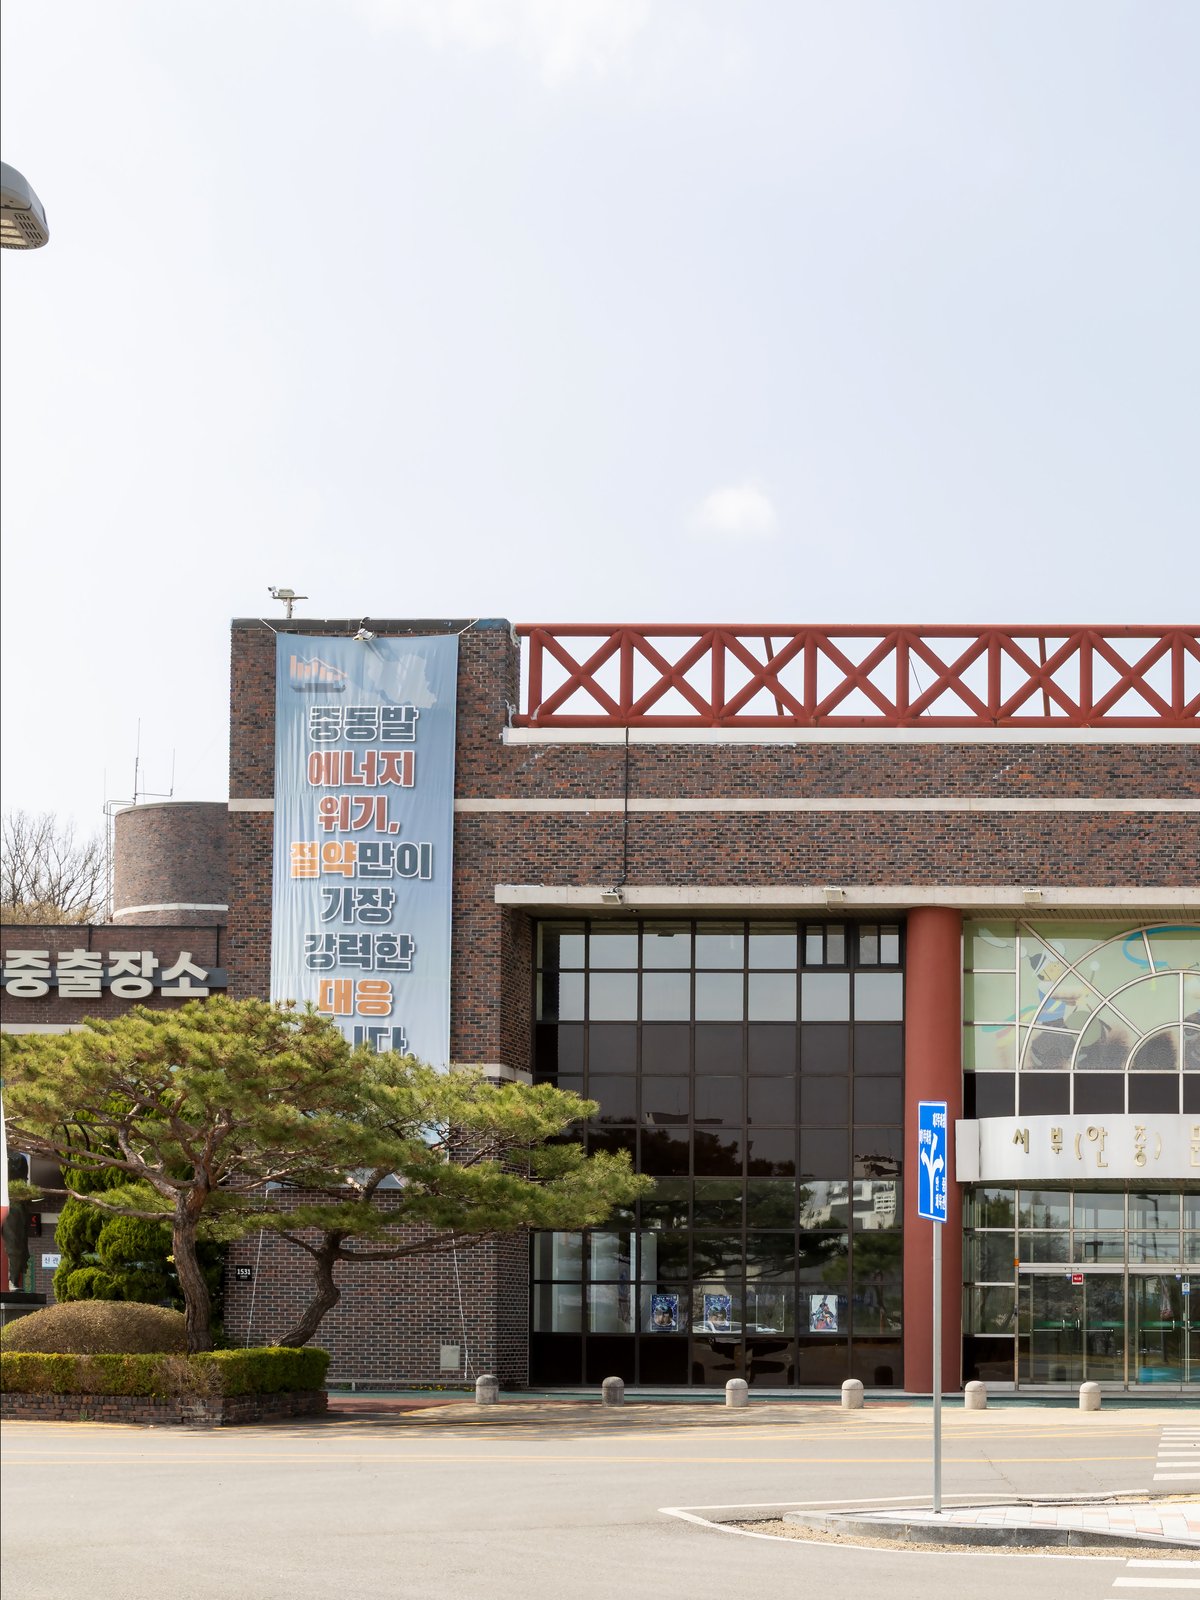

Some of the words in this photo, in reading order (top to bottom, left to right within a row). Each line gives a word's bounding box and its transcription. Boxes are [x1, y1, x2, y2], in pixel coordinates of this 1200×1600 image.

[309, 705, 420, 742] 중동발
[307, 749, 416, 787] 에너지
[317, 794, 401, 834] 위기,
[290, 840, 433, 880] 절약만이
[320, 886, 396, 925] 가장
[304, 932, 415, 971] 강력한
[0, 948, 210, 999] 중출장소
[318, 978, 393, 1016] 대응
